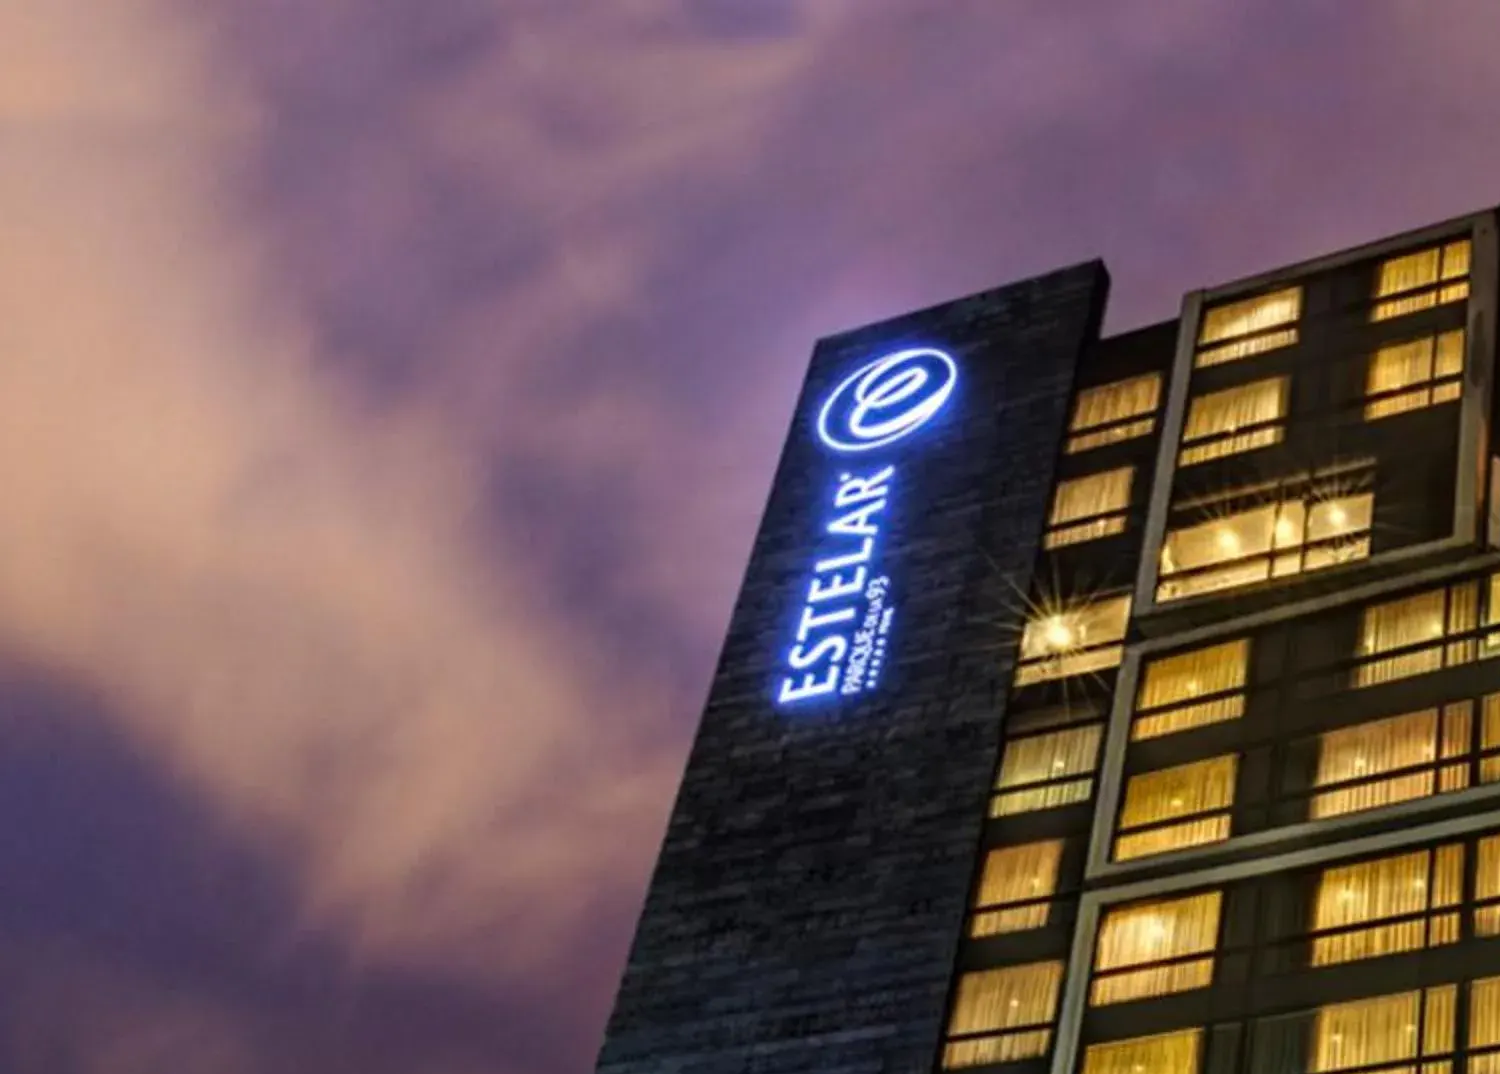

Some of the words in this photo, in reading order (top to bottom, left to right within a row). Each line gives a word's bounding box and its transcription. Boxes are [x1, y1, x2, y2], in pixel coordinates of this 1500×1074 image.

[779, 464, 895, 704] ESTELAR
[841, 630, 876, 694] PARQUE
[865, 575, 891, 600] 93
